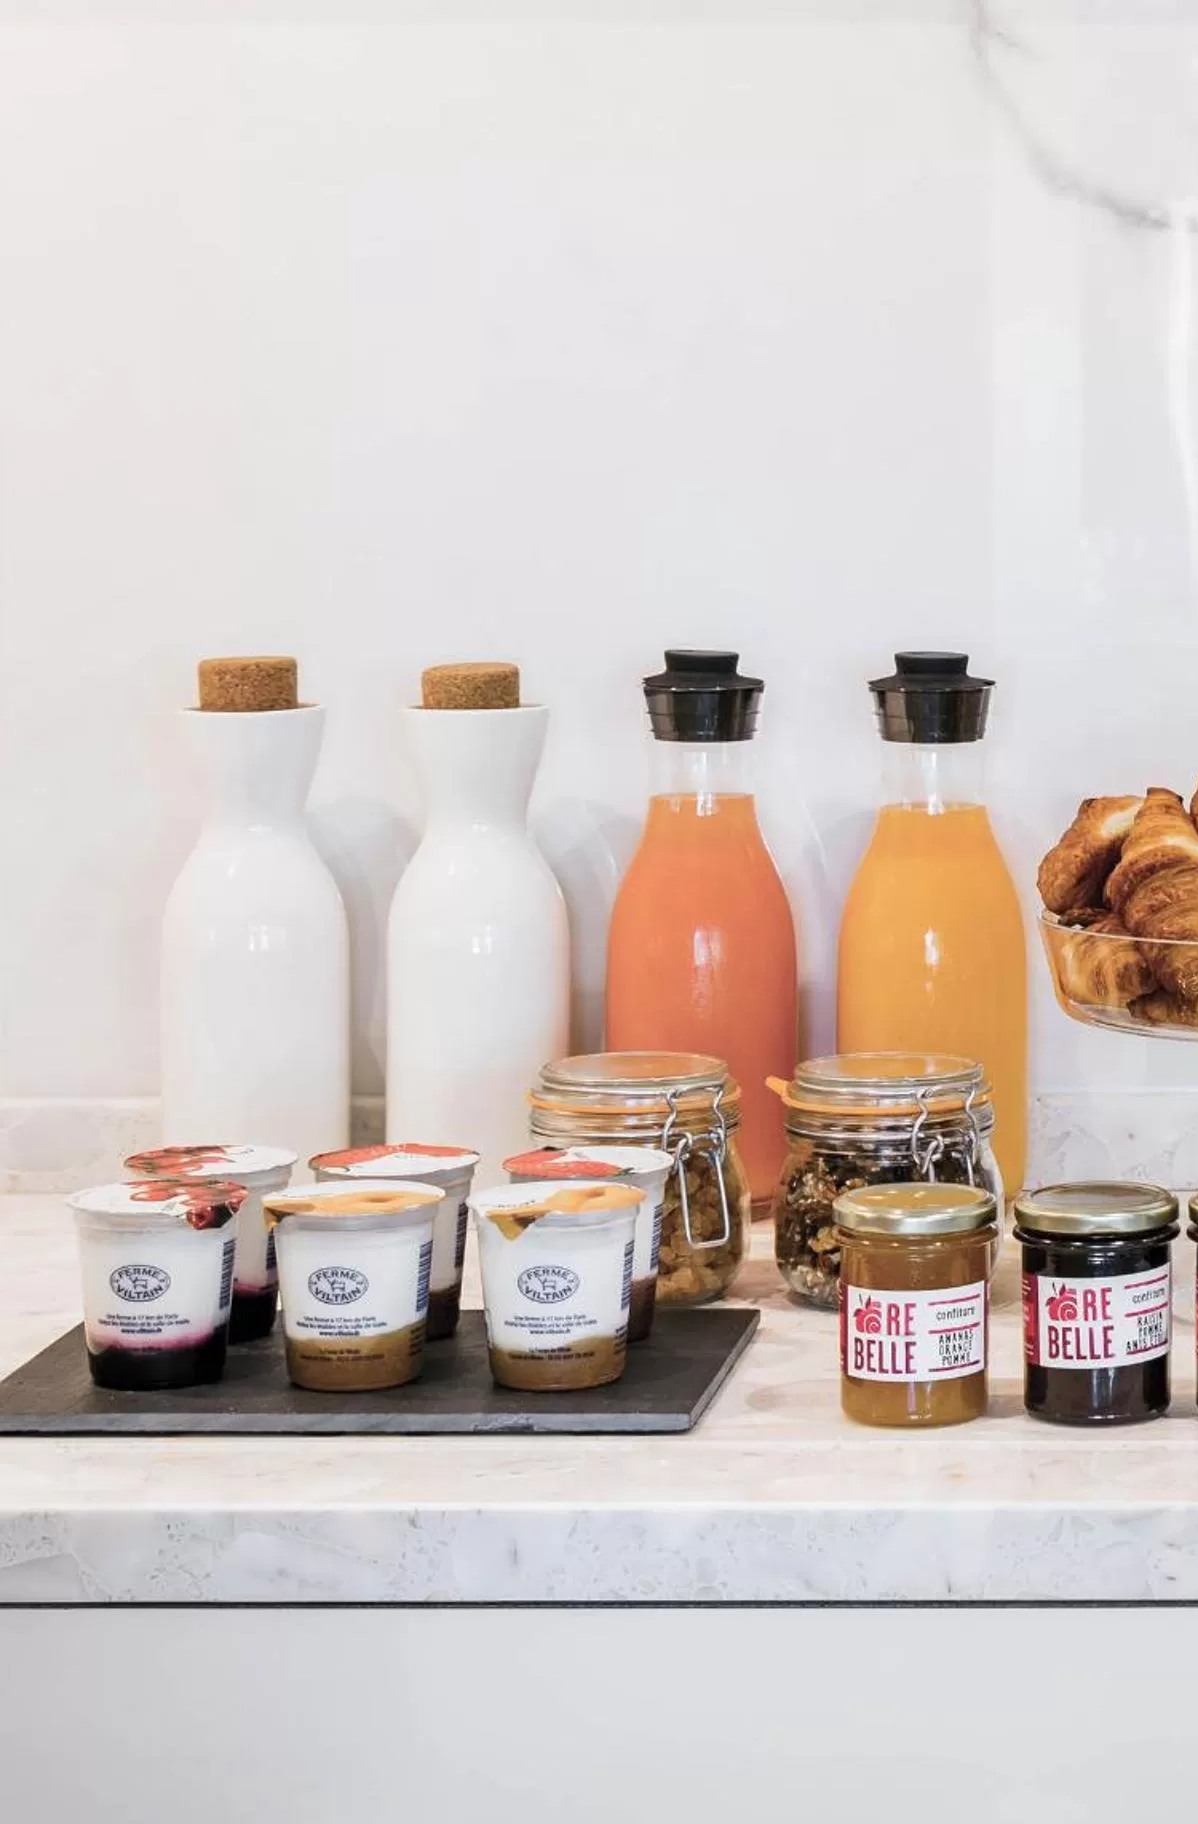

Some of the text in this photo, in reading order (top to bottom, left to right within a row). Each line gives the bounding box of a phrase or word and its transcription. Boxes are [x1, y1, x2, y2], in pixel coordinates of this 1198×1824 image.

[118, 1267, 160, 1279] FERME
[315, 1270, 358, 1282] FERME
[526, 1269, 570, 1280] FERME
[116, 1284, 163, 1300] VILTAIN
[314, 1287, 361, 1302] VILTAIN
[524, 1285, 572, 1301] VILTAIN
[1082, 1287, 1113, 1321] RE
[886, 1303, 917, 1336] RE
[936, 1306, 975, 1321] confiture
[938, 1329, 974, 1344] ANANAS
[1138, 1324, 1163, 1337] POMME
[938, 1340, 973, 1355] ORANGE
[1048, 1326, 1115, 1360] BELLE
[854, 1337, 917, 1374] BELLE
[942, 1352, 971, 1366] POMME
